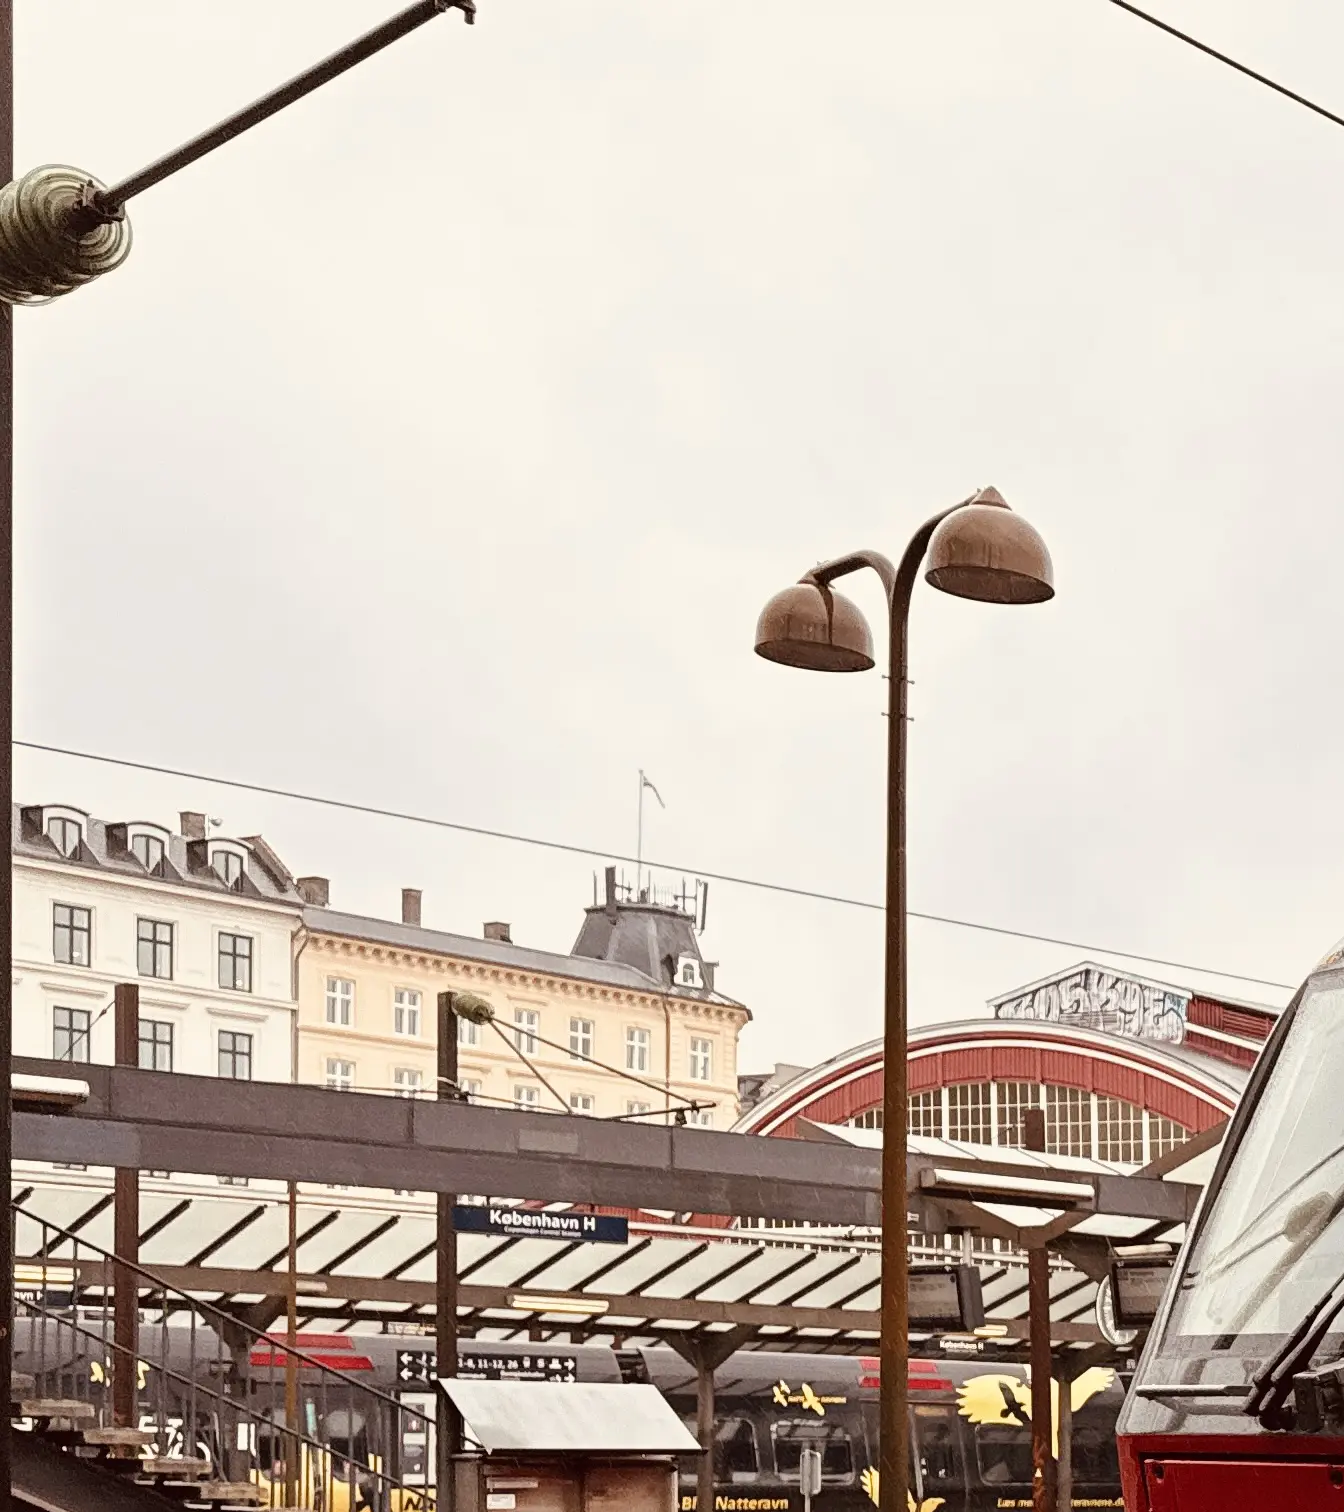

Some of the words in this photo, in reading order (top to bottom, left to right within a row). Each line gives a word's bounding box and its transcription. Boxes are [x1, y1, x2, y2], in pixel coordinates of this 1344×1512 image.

[489, 1208, 579, 1230] København
[583, 1216, 596, 1231] H
[715, 1496, 789, 1511] Natteravn
